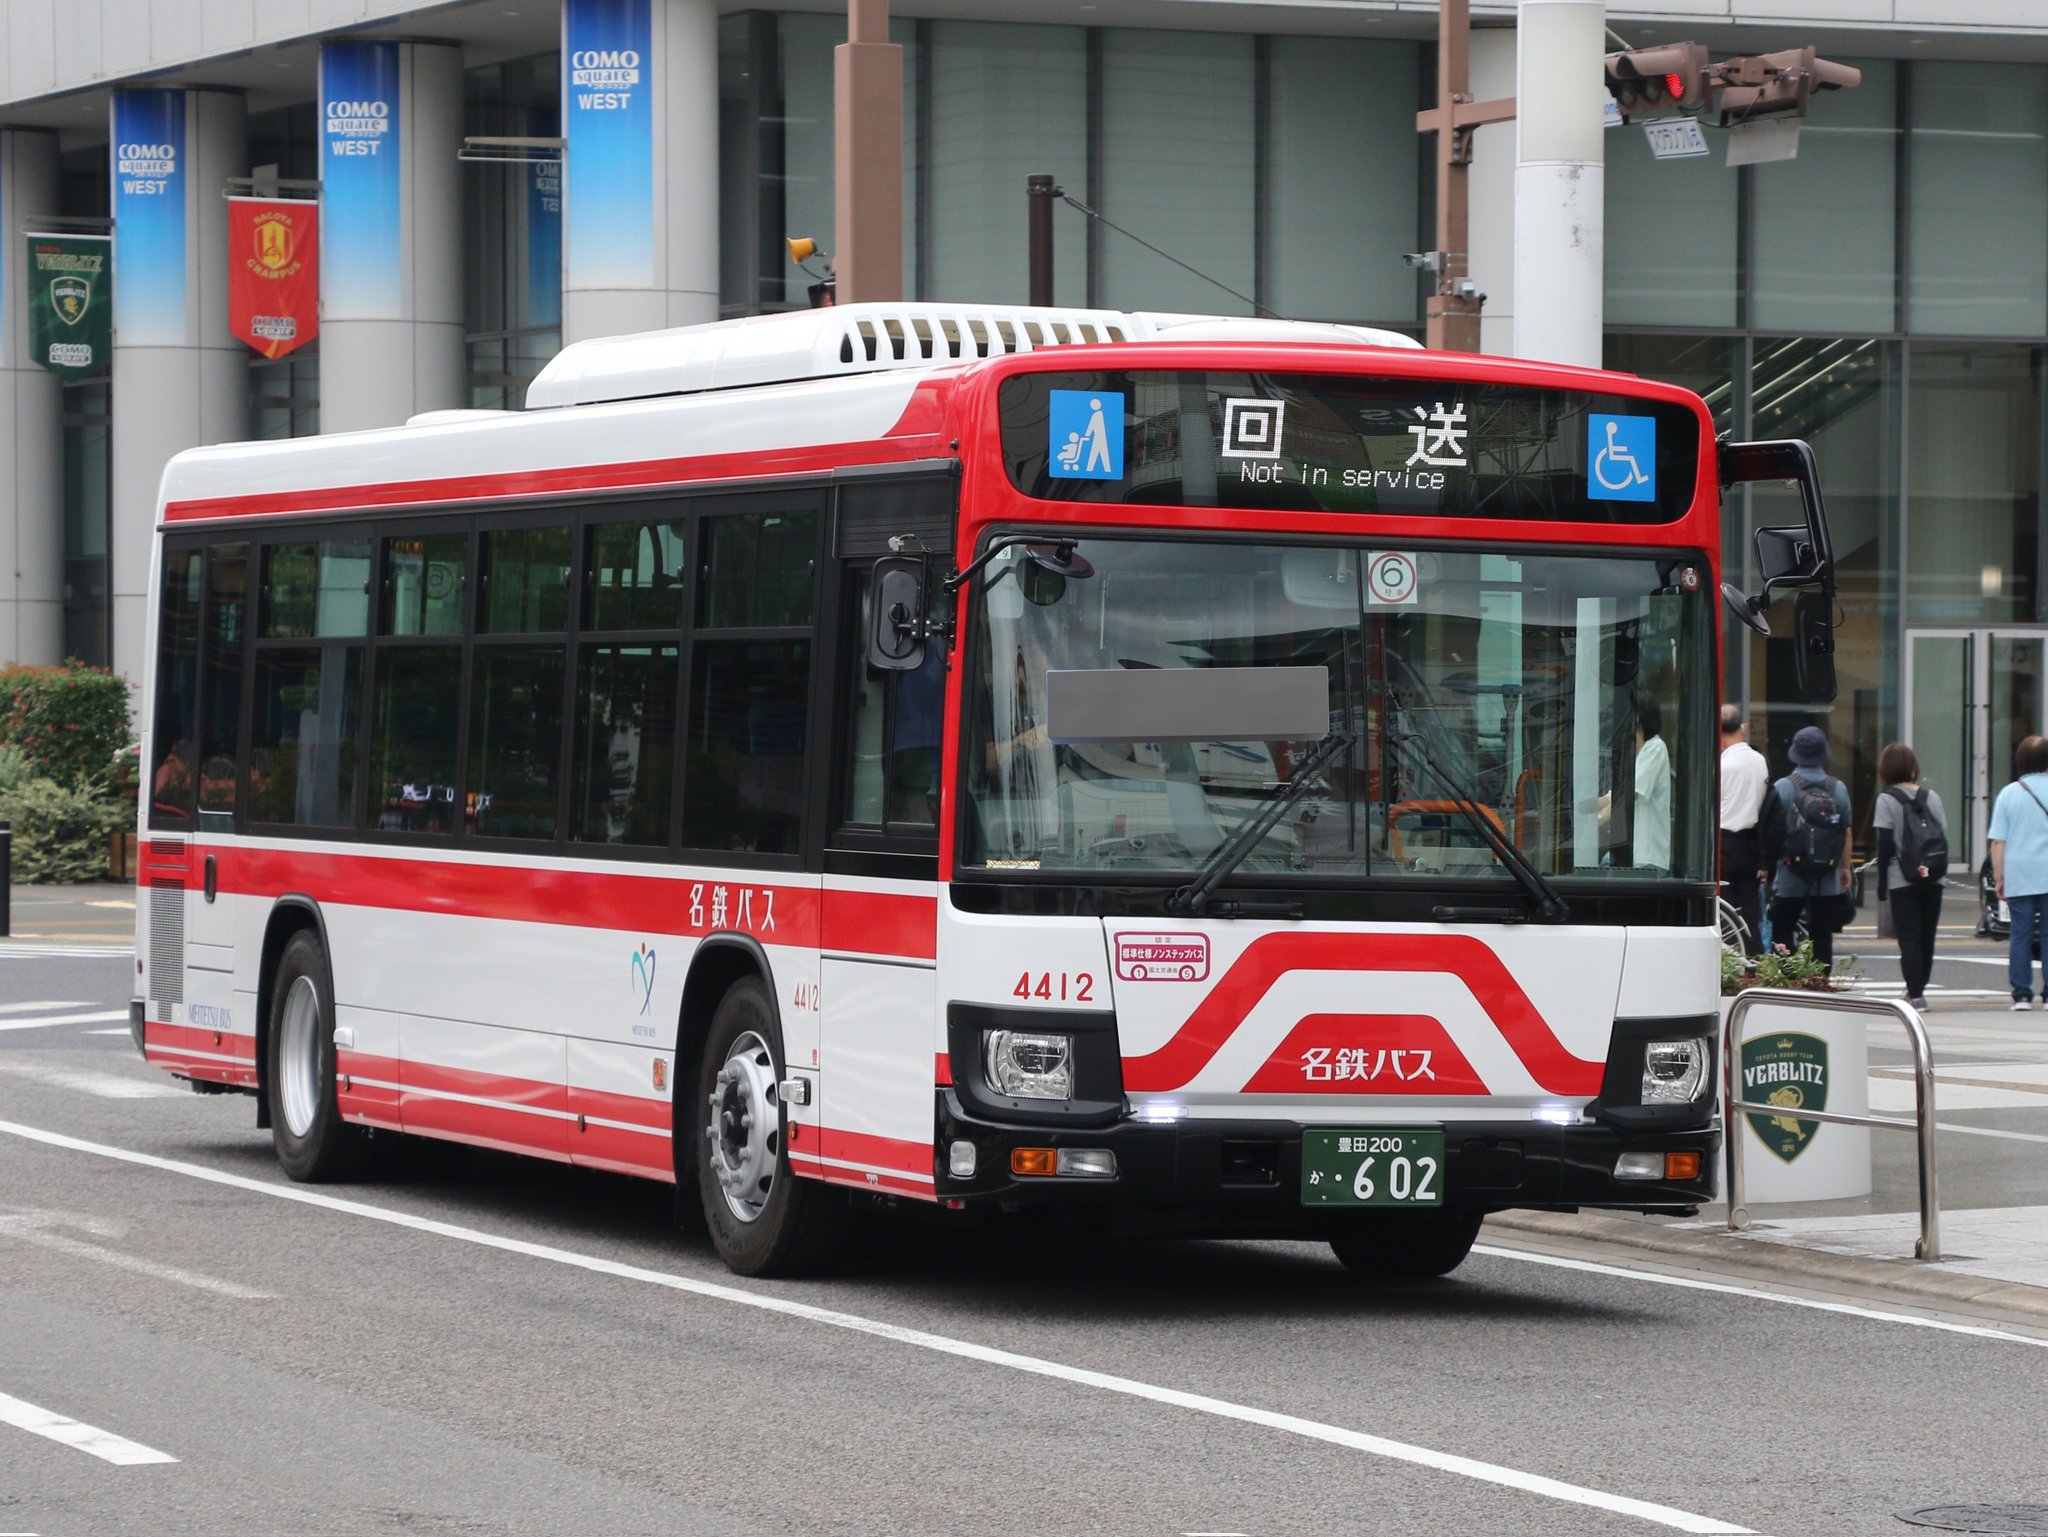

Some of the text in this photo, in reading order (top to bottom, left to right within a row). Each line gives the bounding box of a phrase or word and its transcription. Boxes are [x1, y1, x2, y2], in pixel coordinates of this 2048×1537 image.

[572, 50, 640, 69] COMO
[577, 71, 631, 84] square
[327, 101, 389, 118] COMO
[578, 93, 631, 110] WEST
[331, 120, 380, 132] square
[118, 143, 175, 160] COMO
[332, 141, 381, 156] WEST
[121, 161, 168, 172] square
[123, 180, 168, 194] WEST
[253, 212, 292, 225] NAGOYA
[247, 258, 301, 280] GRAMPUS
[253, 316, 295, 327] COMO
[1240, 460, 1445, 490] Not in service
[1381, 557, 1404, 587] 6
[689, 883, 775, 932] 名鉄バス
[1122, 947, 1204, 959] 標準仕様ノンステップバス
[1013, 971, 1093, 1001] 4412
[794, 982, 819, 1012] 4412
[189, 1004, 232, 1029] MEITETSU BUS
[1300, 1047, 1436, 1082] 名鉄バス
[1755, 1053, 1777, 1062] TOYOTA
[1744, 1061, 1824, 1087] VERBLITZ
[1309, 1170, 1324, 1185] か
